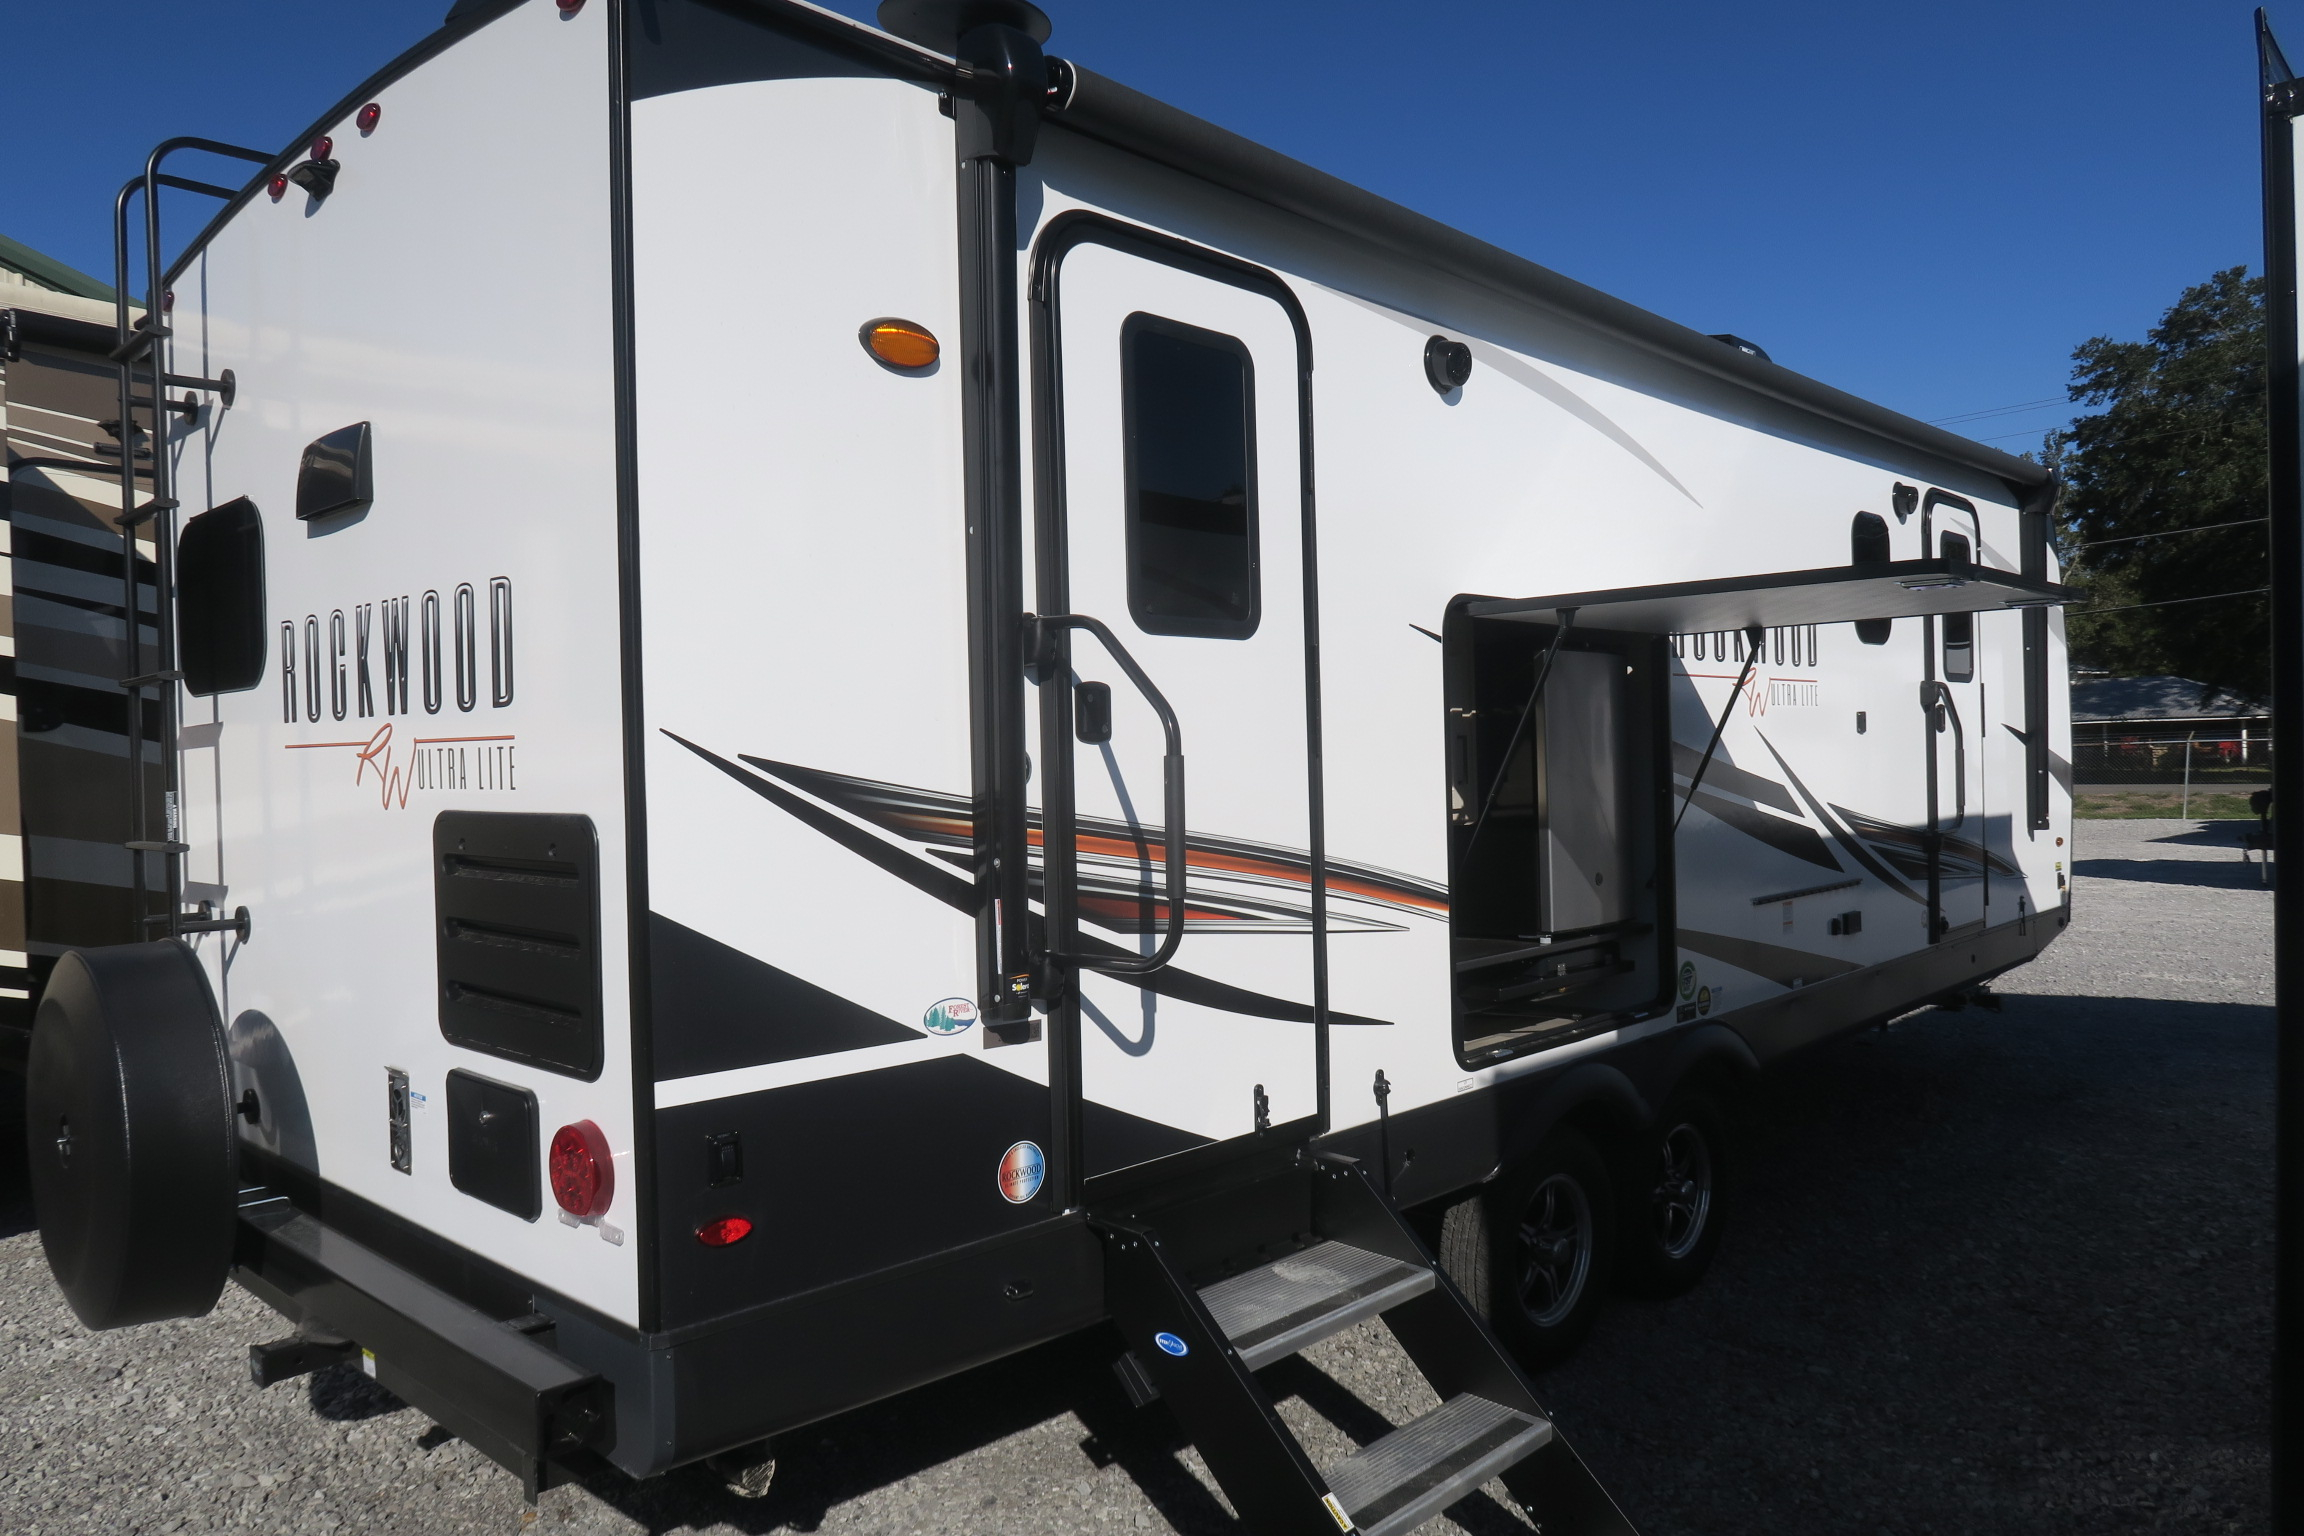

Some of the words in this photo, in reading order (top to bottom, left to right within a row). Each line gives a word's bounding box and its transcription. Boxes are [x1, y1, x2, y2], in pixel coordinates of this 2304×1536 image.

[281, 575, 514, 724] ROCKWOOD
[1771, 683, 1797, 706] ULTRA
[1802, 685, 1819, 707] LITE
[417, 747, 467, 790] ULTRA
[478, 746, 516, 790] LITE
[1002, 1163, 1042, 1182] ROCKWOOD
[1324, 1497, 1344, 1525] CAUTION
